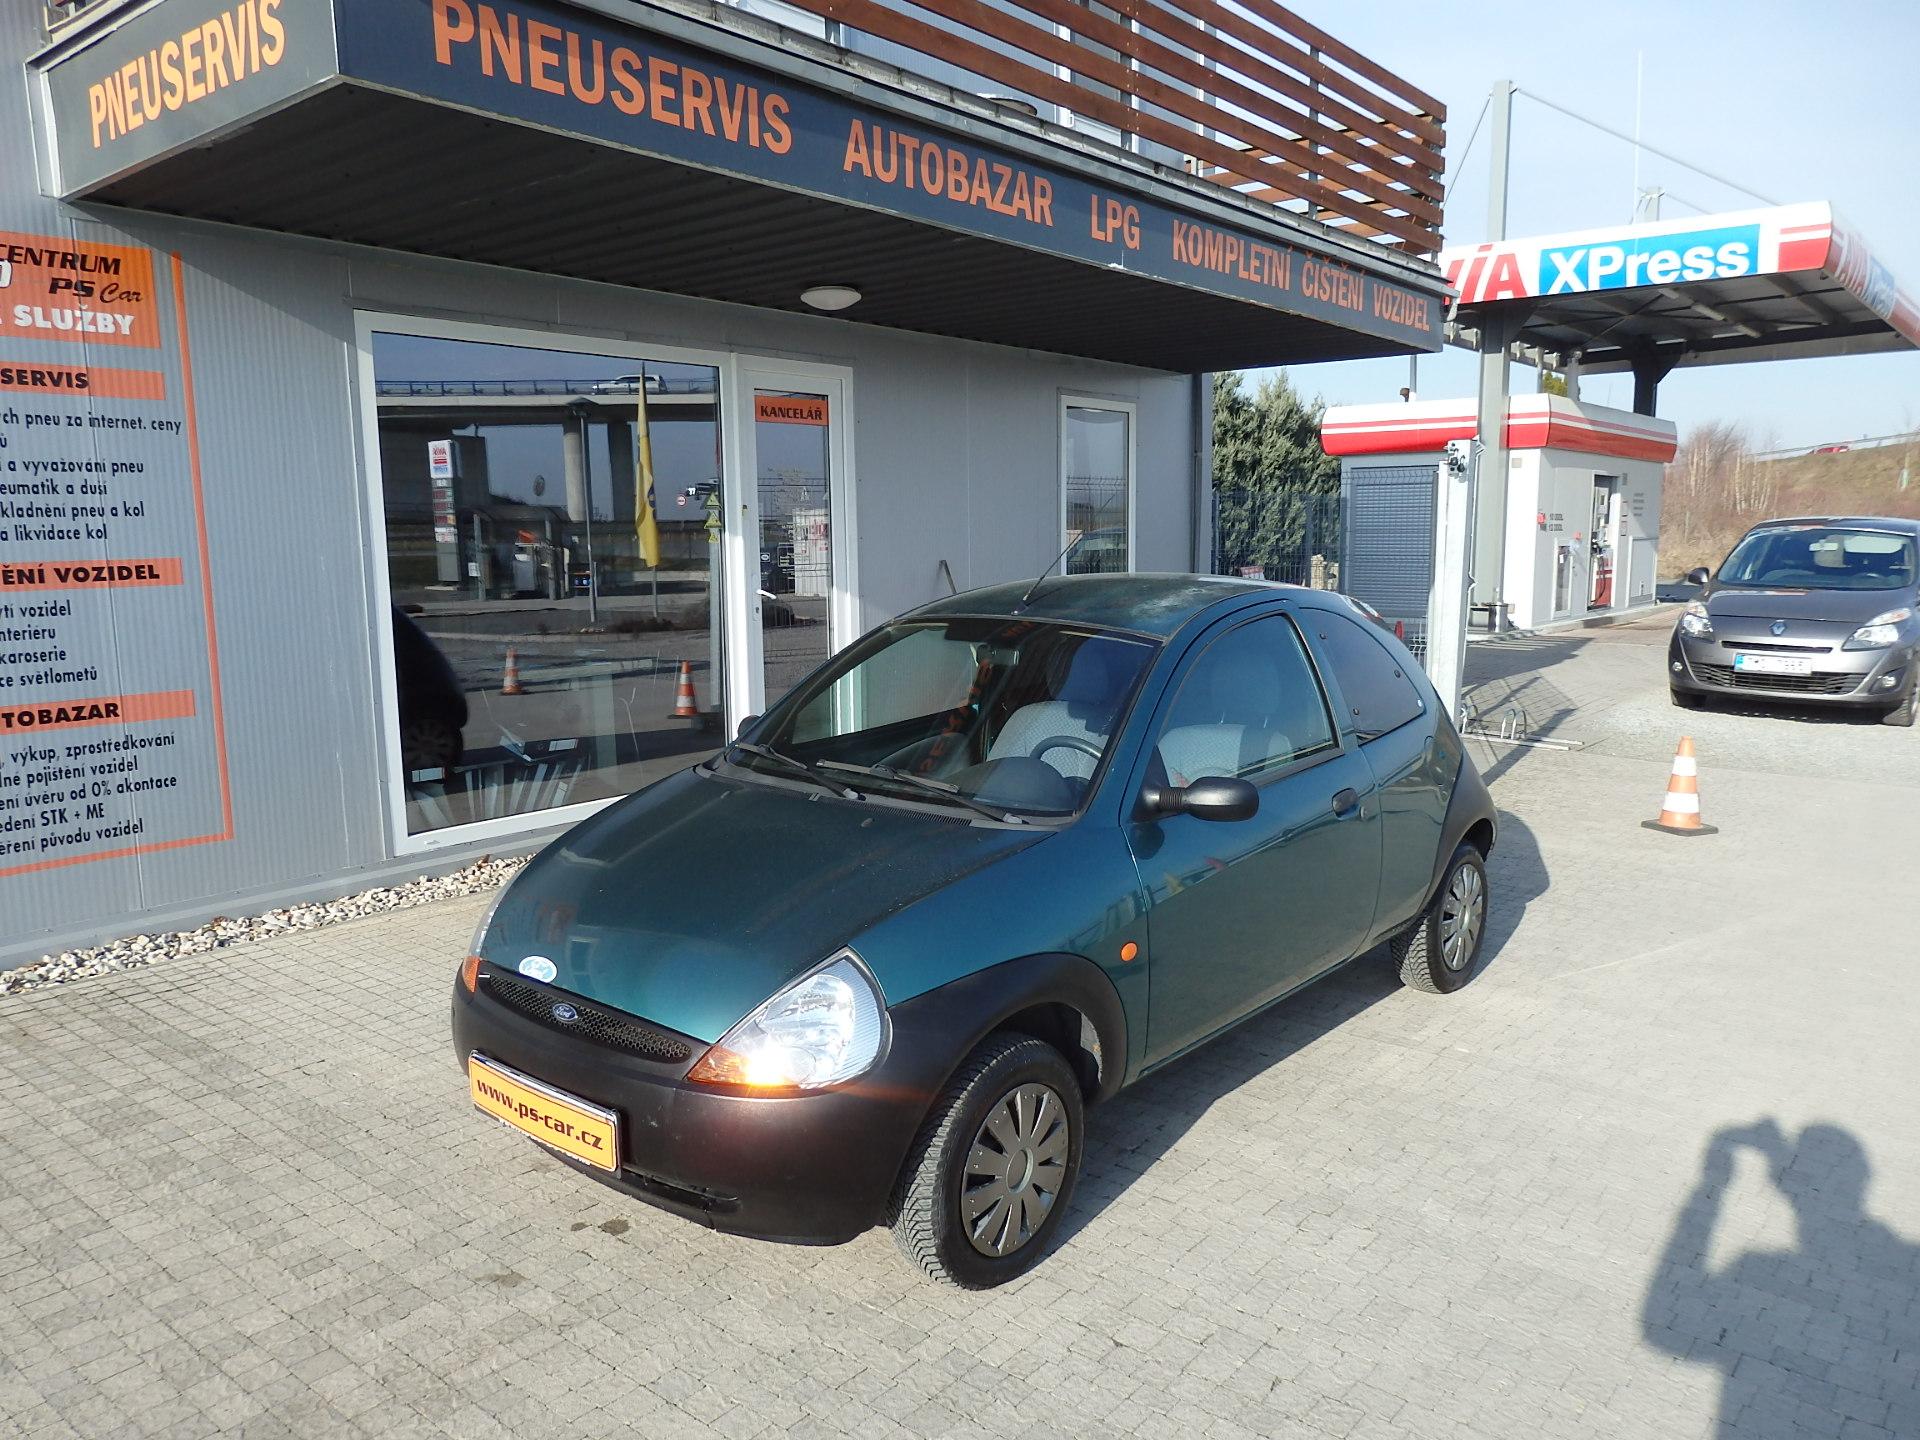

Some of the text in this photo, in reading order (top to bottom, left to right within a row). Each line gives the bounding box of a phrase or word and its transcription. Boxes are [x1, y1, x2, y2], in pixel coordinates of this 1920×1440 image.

[89, 0, 285, 148] PNEUSERVIS
[431, 0, 1430, 332] PNEUSERVIS AUTOBAZAR LPG KOMPLETNÍ ČIŠTĚNÍ VOZIDEL
[1545, 241, 1750, 295] XPress
[48, 277, 95, 298] PS
[14, 304, 136, 335] SLUŽBY
[0, 367, 89, 389] SERVIS
[25, 413, 60, 429] pneu
[66, 415, 83, 427] za
[88, 411, 147, 430] internet.
[151, 419, 182, 435] ceny
[760, 405, 823, 421] KANCELÁŘ
[8, 457, 144, 477] a vyvažování pneu
[0, 478, 60, 495] eumatik
[66, 484, 74, 495] a
[72, 504, 105, 521] pneu
[110, 506, 118, 517] a
[124, 500, 145, 517] kol
[15, 523, 80, 541] likvidace
[86, 523, 108, 540] kol
[2, 563, 160, 585] ĚNÍ VOZIDEL
[20, 599, 72, 617] vozidel
[0, 645, 67, 664] karoserie
[20, 666, 98, 686] světlometů
[2, 702, 120, 728] TOBAZAR
[11, 745, 60, 767] výkup,
[66, 731, 175, 759] zprostředkování
[27, 762, 85, 788] pojištění
[90, 755, 138, 776] vozidel
[70, 785, 87, 801] od
[91, 780, 112, 798] 0%
[116, 775, 177, 795] akontace
[40, 808, 69, 827] STK
[86, 802, 105, 820] ME
[41, 828, 91, 852] původu
[96, 818, 144, 839] vozidel
[476, 1079, 604, 1151] www.ps-car.cz
